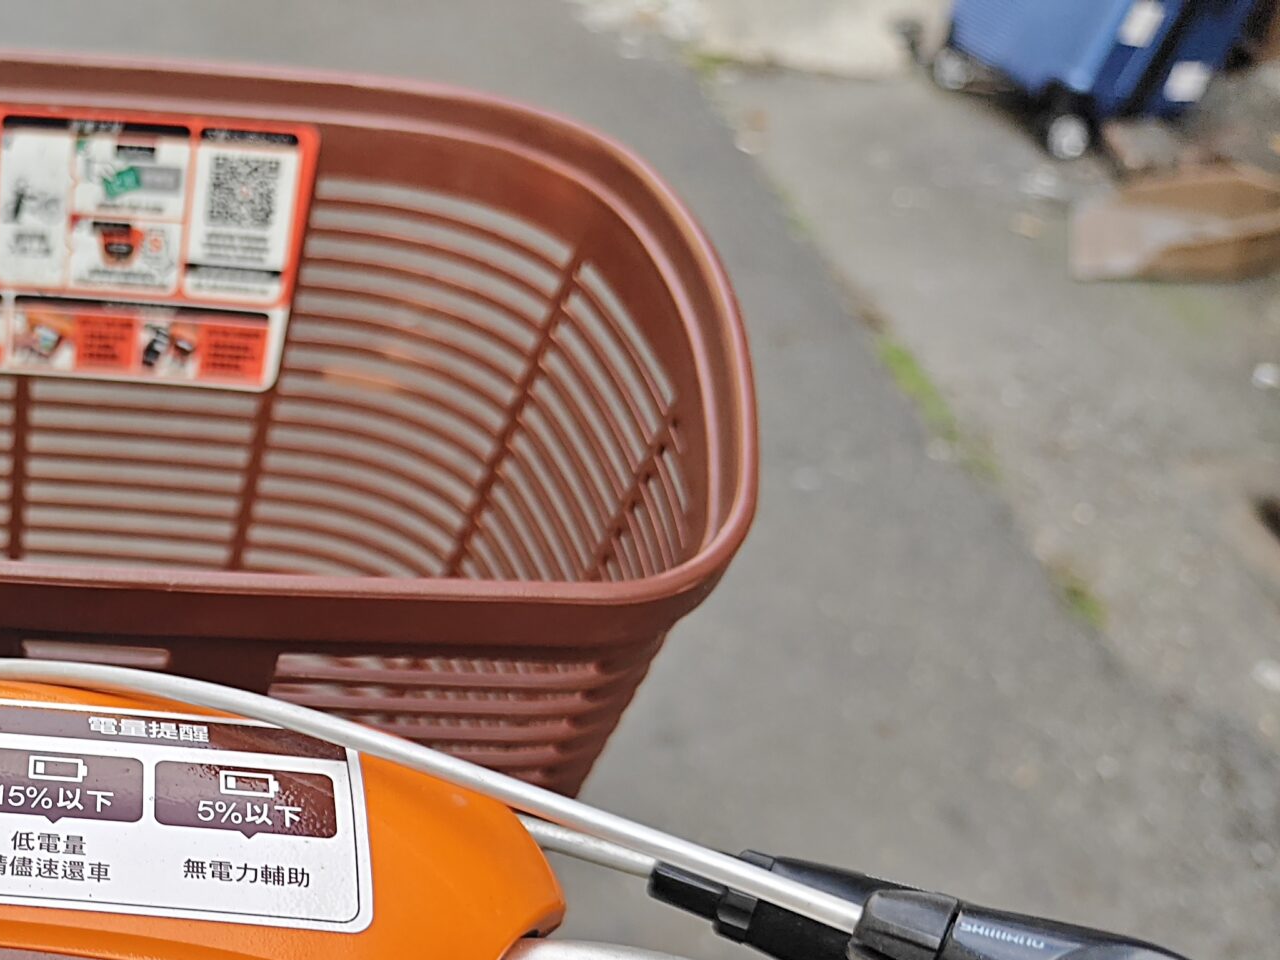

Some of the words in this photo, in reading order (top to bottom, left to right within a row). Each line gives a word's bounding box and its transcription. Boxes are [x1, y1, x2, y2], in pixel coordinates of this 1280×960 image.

[88, 717, 210, 743] 電量提醒
[197, 800, 303, 828] 5%以下
[10, 830, 87, 856] 低電量
[182, 858, 311, 888] 無電力輔助
